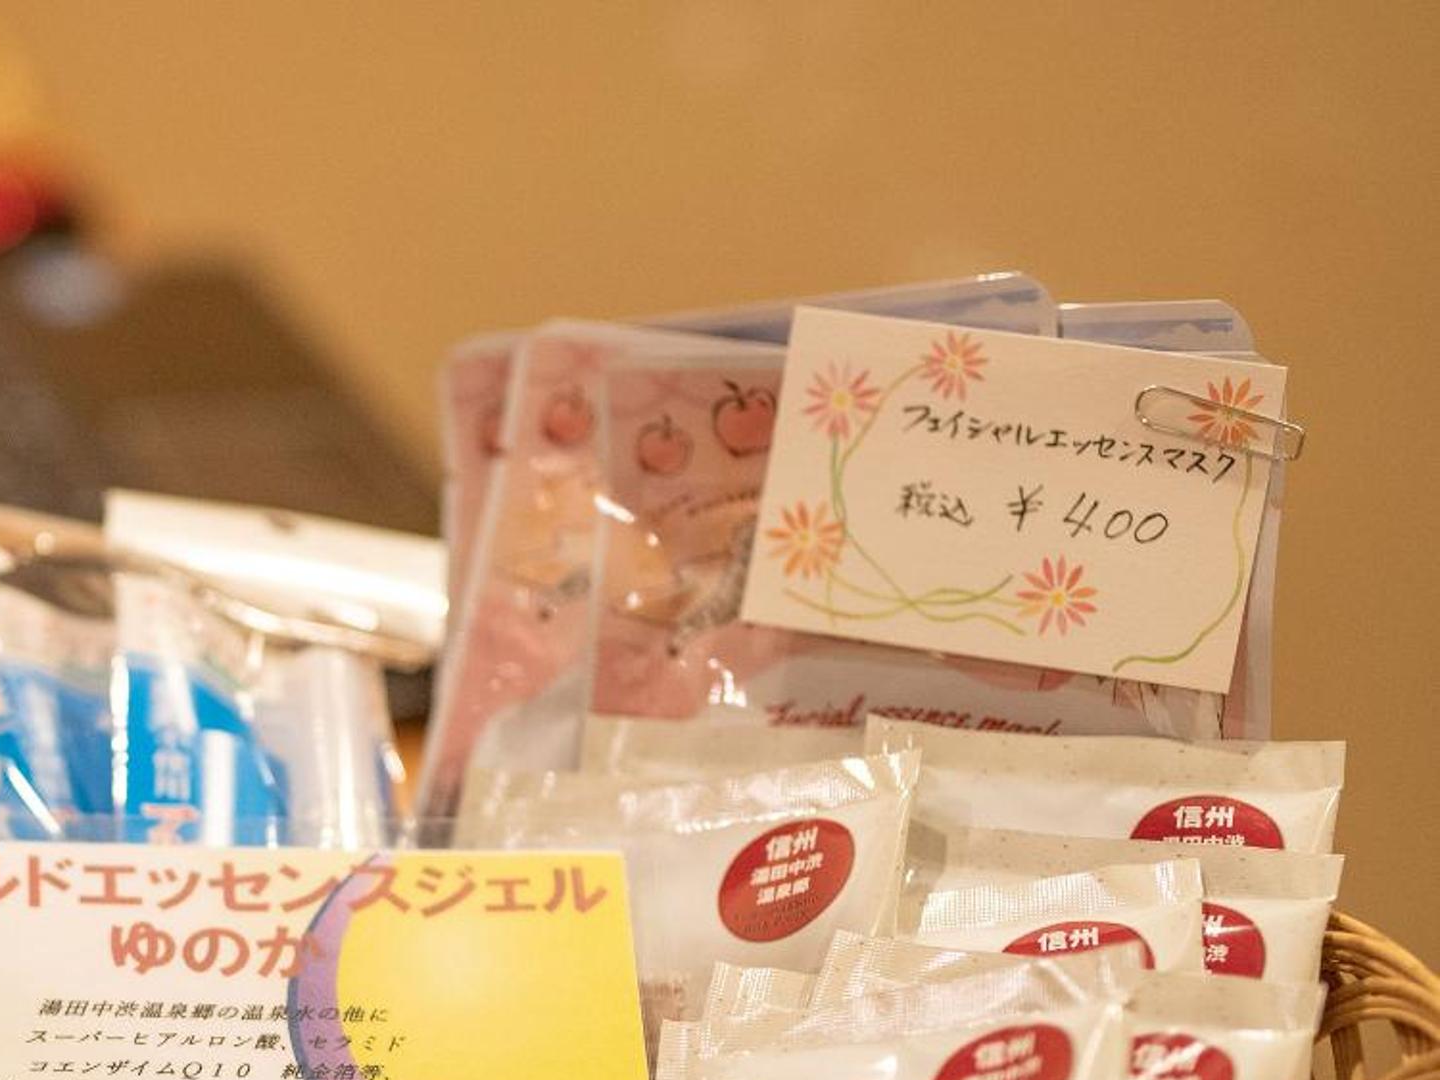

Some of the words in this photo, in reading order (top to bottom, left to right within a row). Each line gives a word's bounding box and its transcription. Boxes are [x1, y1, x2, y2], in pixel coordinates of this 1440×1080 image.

[895, 480, 975, 528] 税込
[1172, 804, 1236, 830] 信州
[765, 825, 820, 862] 信州
[110, 920, 326, 979] ゆのか
[1037, 926, 1100, 952] 信州
